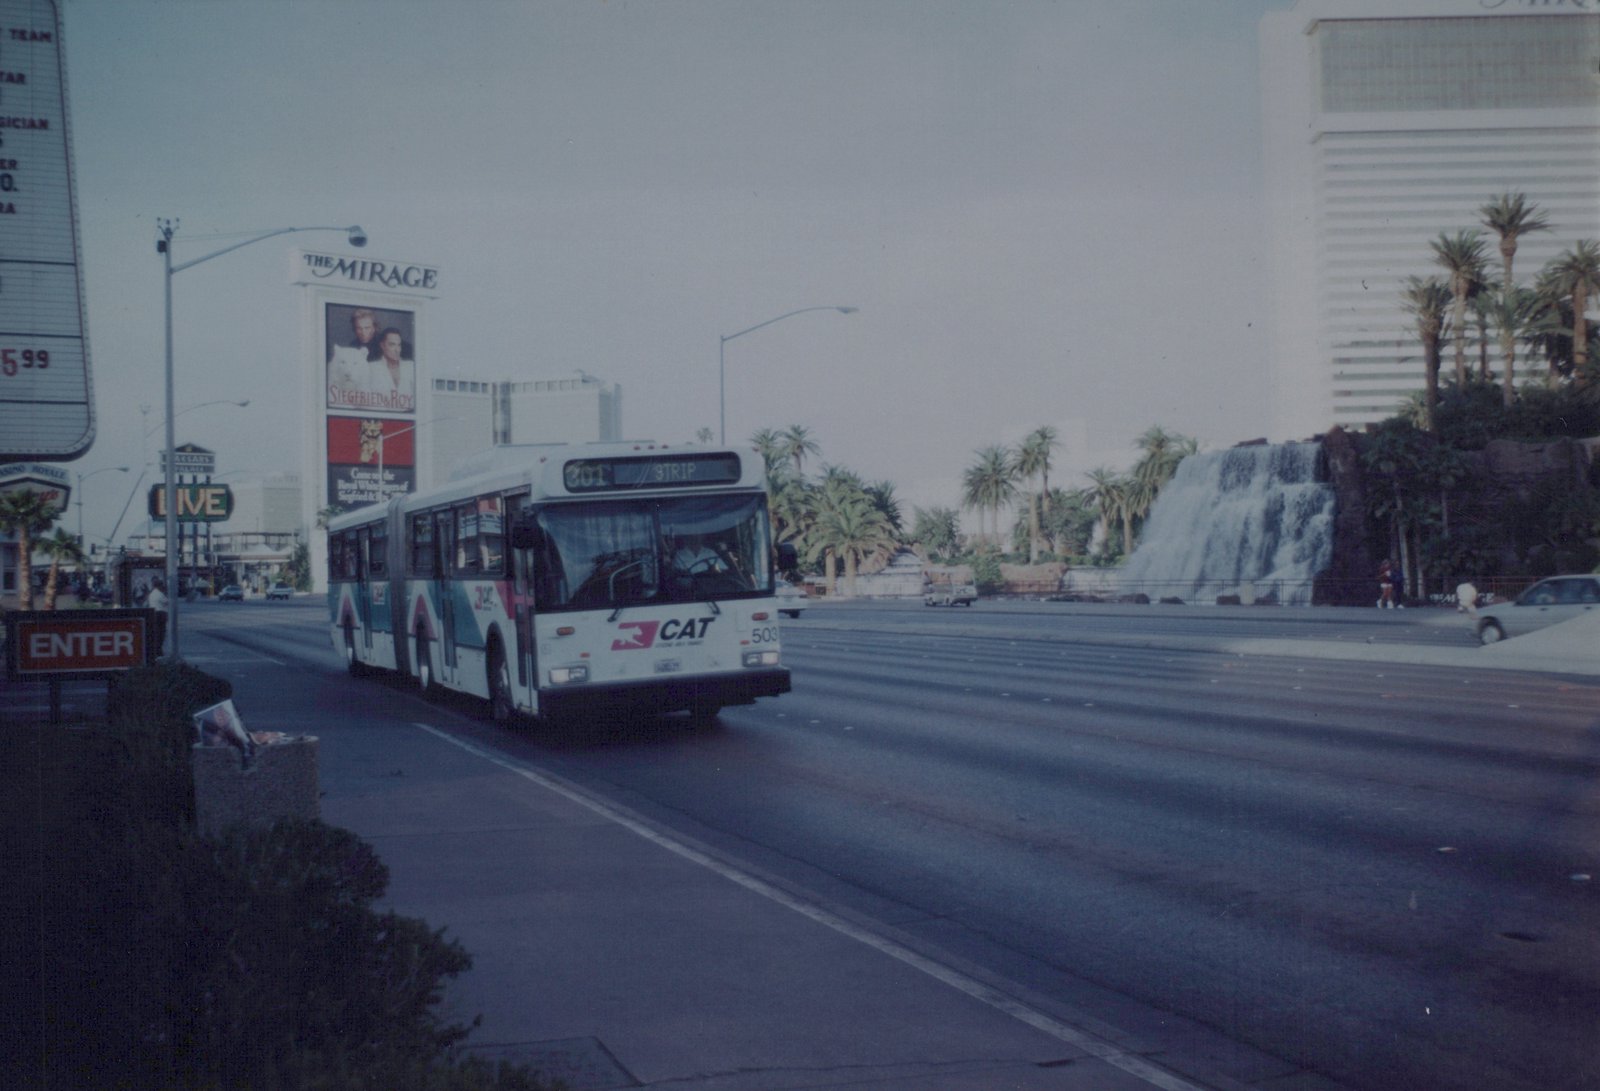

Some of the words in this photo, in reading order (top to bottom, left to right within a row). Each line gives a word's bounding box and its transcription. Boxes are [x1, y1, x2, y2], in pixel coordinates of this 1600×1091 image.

[9, 28, 51, 43] TEAM
[303, 254, 334, 268] THE
[312, 258, 438, 289] MIRAGE
[655, 463, 697, 481] STRIP
[157, 488, 226, 516] LIVE
[660, 617, 716, 641] CAT
[752, 624, 777, 643] 503
[29, 631, 134, 658] ENTER
